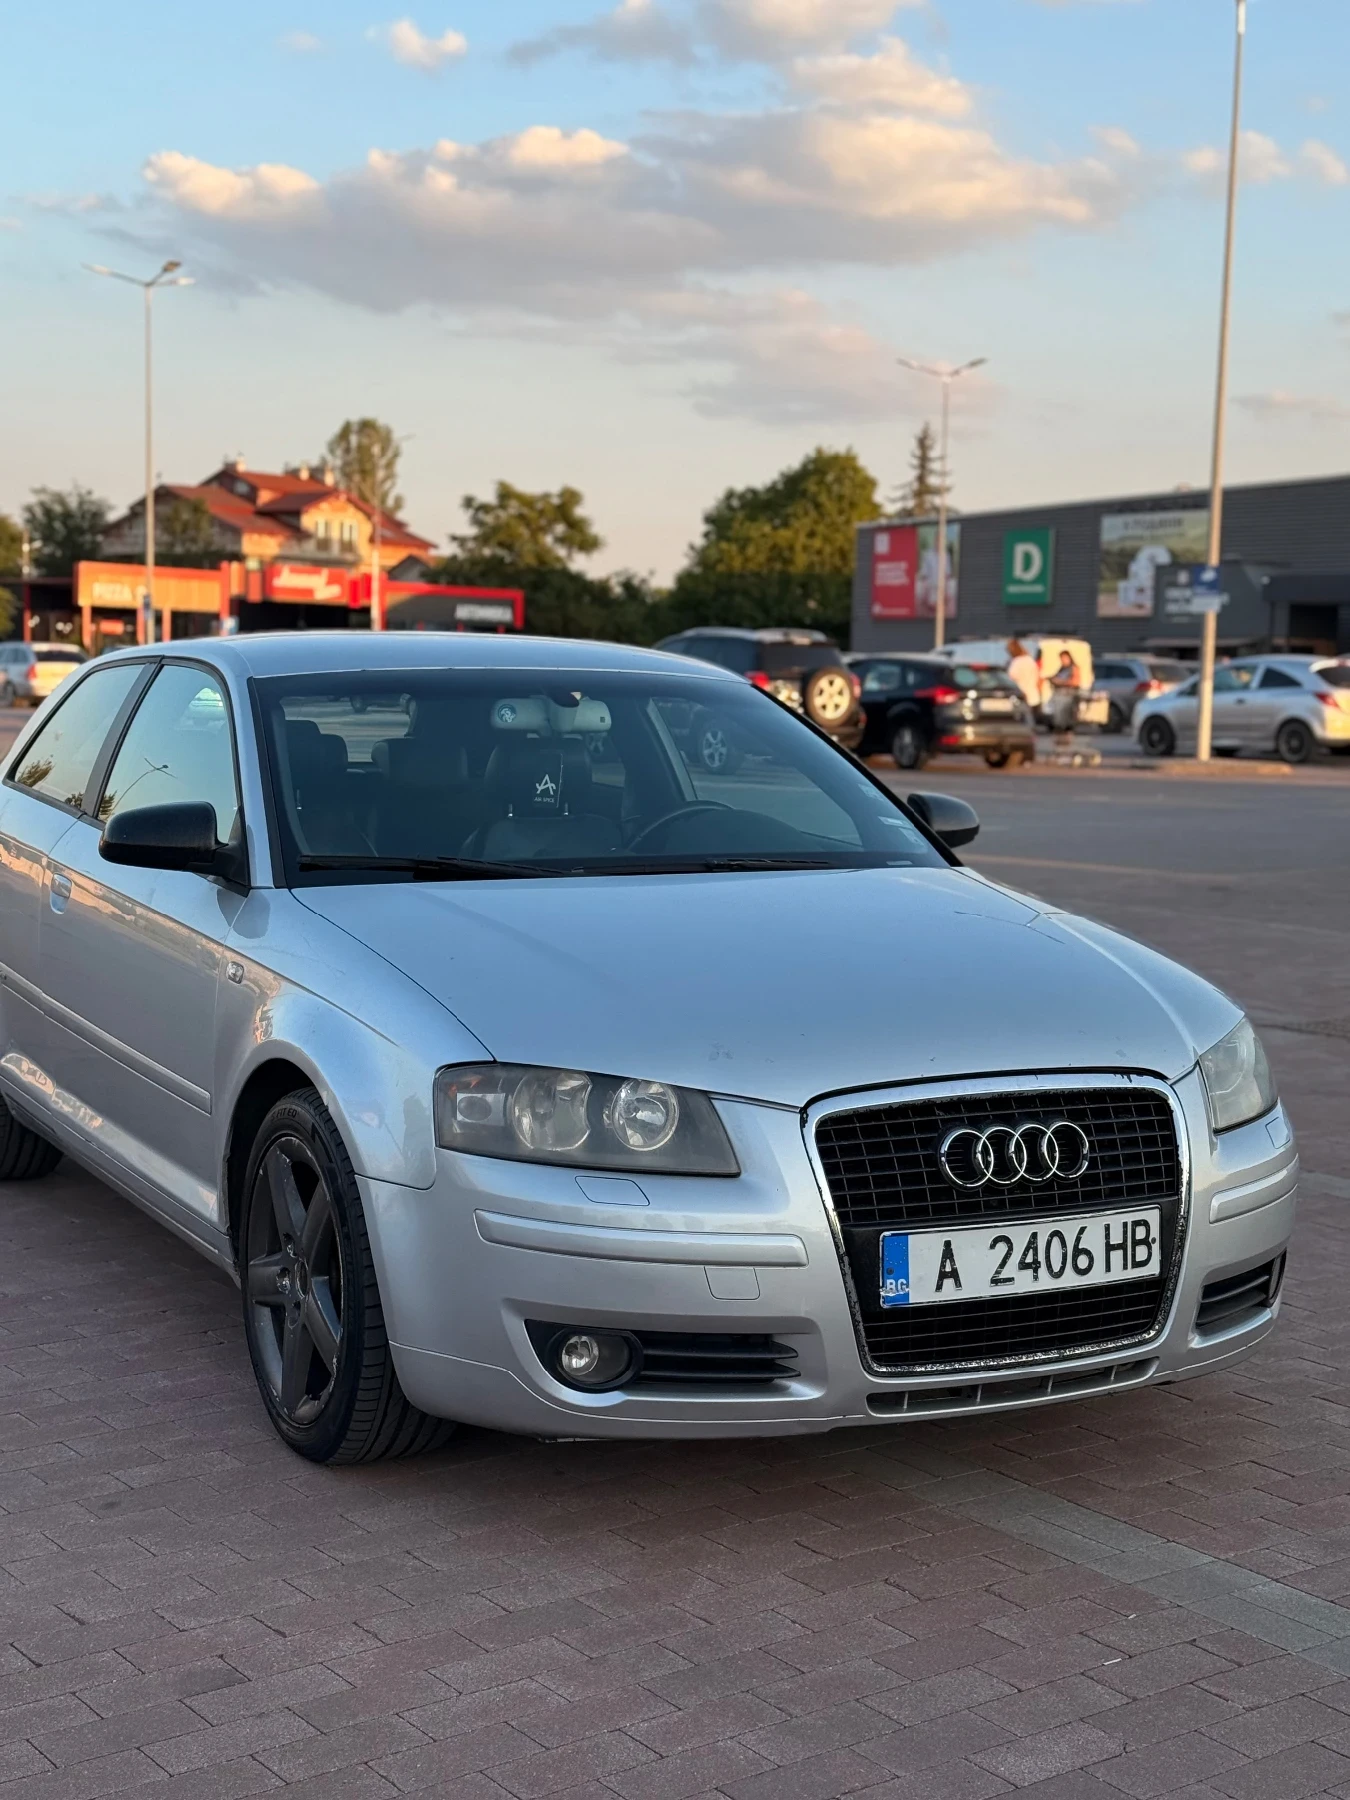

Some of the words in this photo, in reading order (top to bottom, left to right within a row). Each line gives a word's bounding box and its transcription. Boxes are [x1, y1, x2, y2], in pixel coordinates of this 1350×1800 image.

[1013, 542, 1043, 582] D
[935, 1239, 962, 1292] A
[989, 1226, 1094, 1287] 2406
[1104, 1219, 1153, 1273] HB
[886, 1278, 908, 1295] BG
